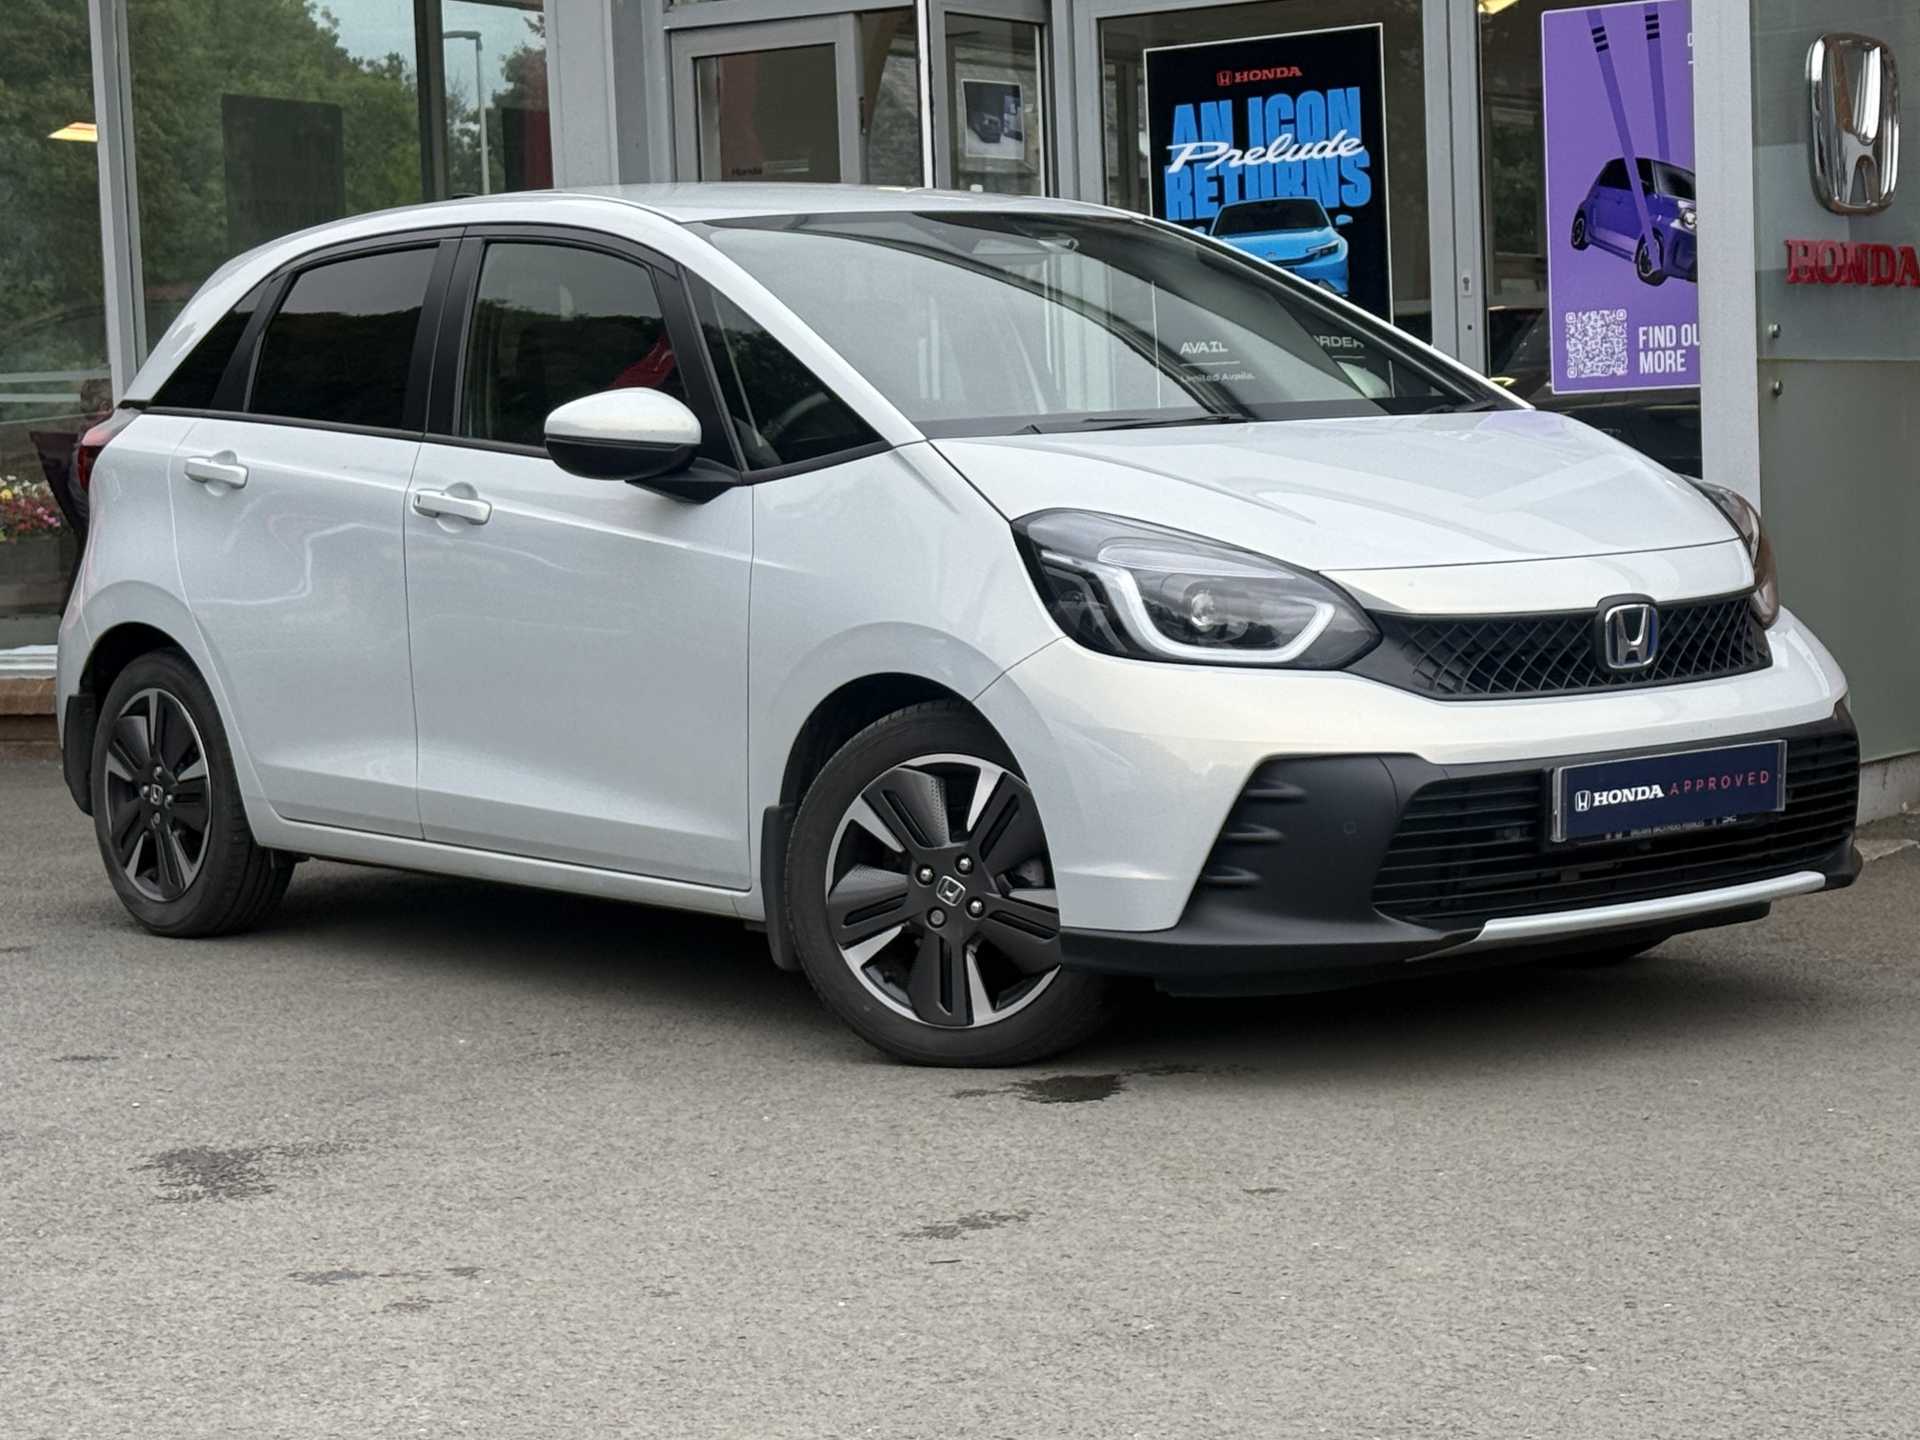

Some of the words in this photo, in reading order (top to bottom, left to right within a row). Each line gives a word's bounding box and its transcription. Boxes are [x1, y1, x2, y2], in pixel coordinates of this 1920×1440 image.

[1234, 66, 1302, 83] HONDA
[1172, 98, 1234, 163] AN
[1248, 86, 1363, 151] ICON
[1166, 129, 1365, 174] Prelude
[1164, 150, 1372, 221] RETURNS
[1784, 238, 1920, 287] HONDA
[1639, 324, 1677, 350] FIND
[1639, 349, 1687, 374] MORE
[1593, 784, 1665, 807] HONDA
[1670, 770, 1770, 797] APPROVED
